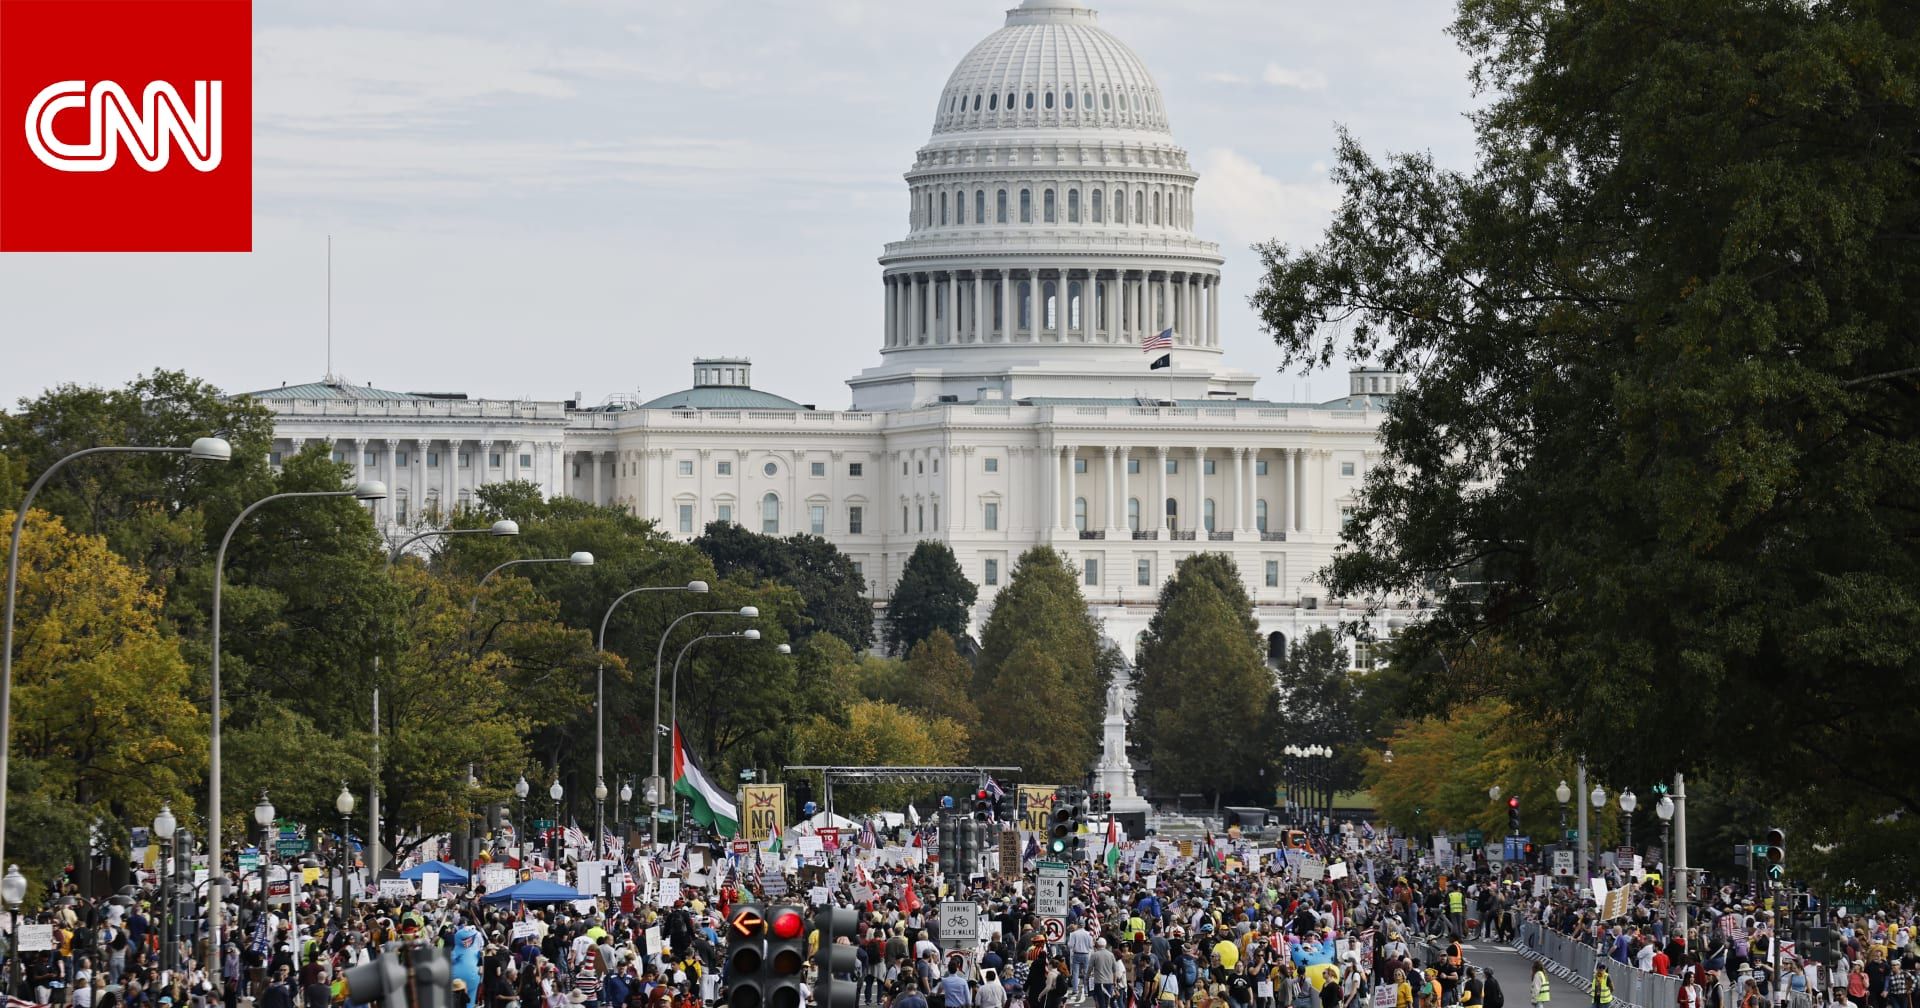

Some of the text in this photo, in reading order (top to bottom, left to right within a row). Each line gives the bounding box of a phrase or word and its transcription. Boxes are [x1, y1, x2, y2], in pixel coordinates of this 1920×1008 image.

[752, 810, 775, 829] NO
[1026, 811, 1048, 830] NO
[752, 830, 770, 838] KING
